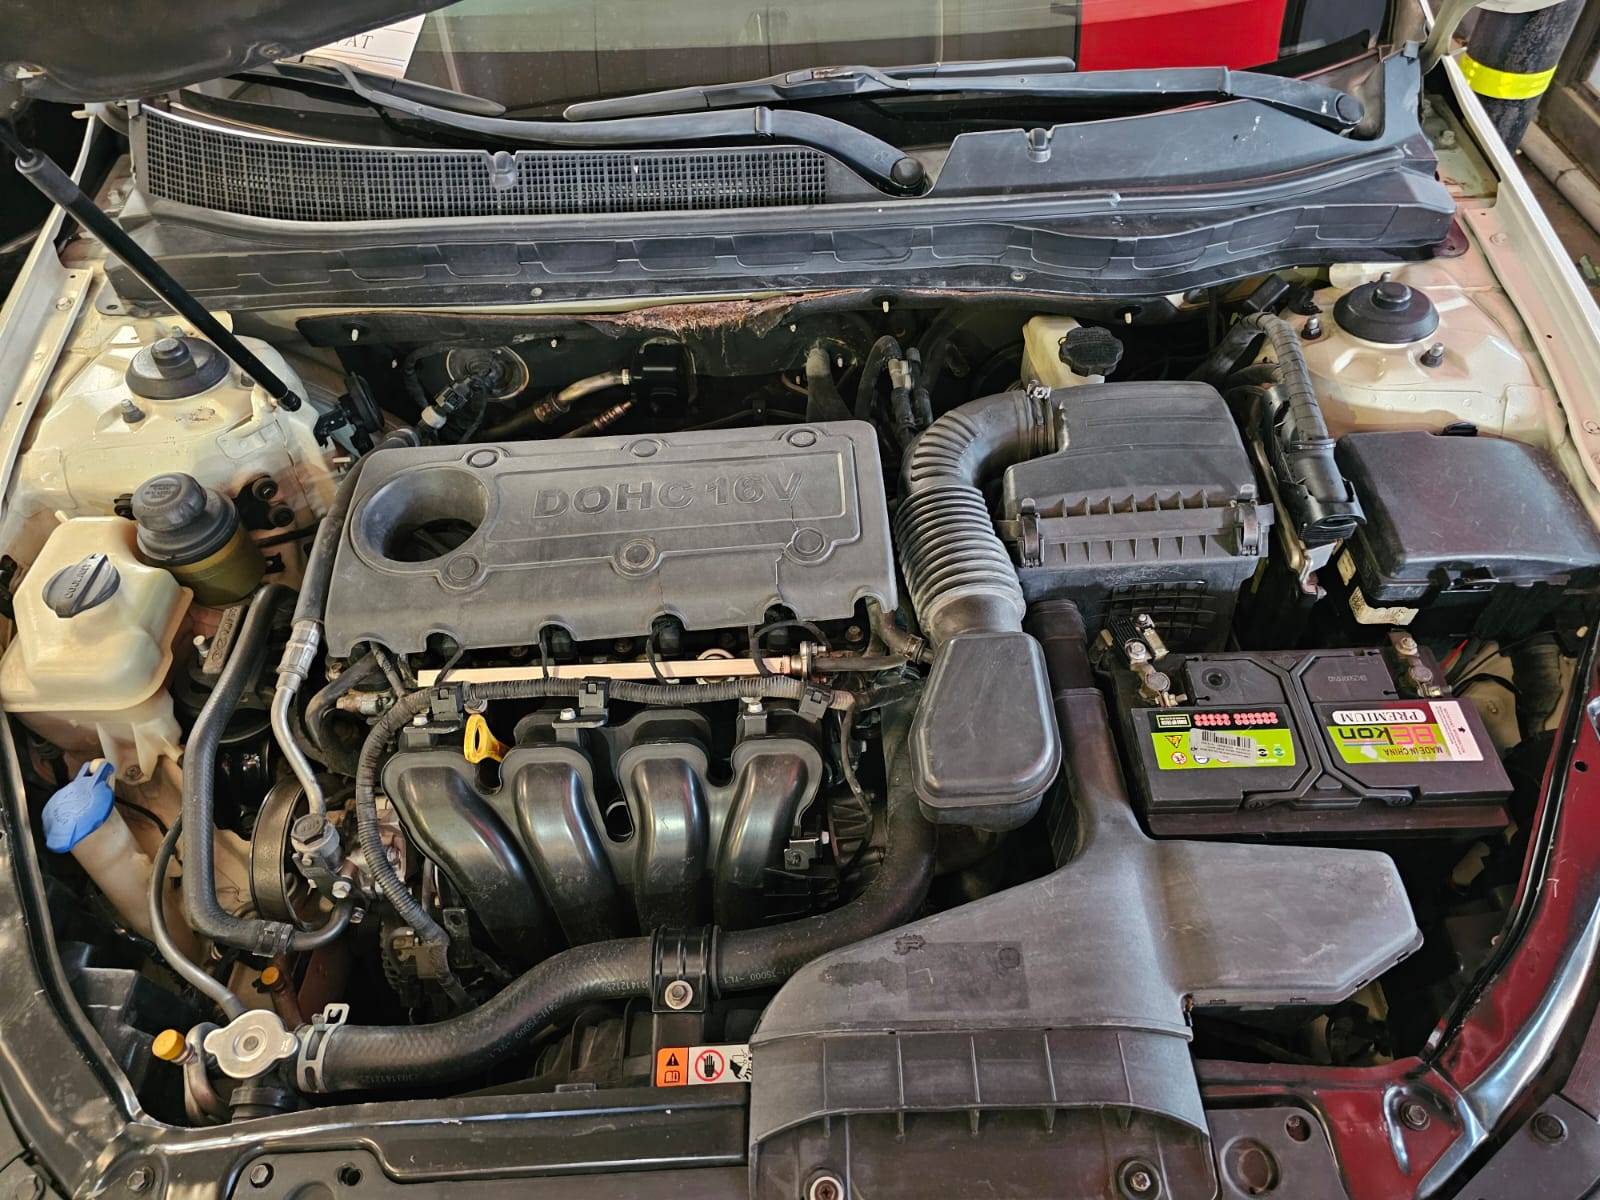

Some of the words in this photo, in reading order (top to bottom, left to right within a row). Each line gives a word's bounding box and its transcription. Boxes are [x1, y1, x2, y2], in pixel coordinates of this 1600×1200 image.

[336, 34, 374, 49] AT
[532, 478, 694, 519] DOHC
[705, 471, 804, 506] 16V
[1340, 711, 1419, 723] PREMIUM
[1383, 748, 1408, 756] CHINA
[1419, 746, 1443, 756] MADE
